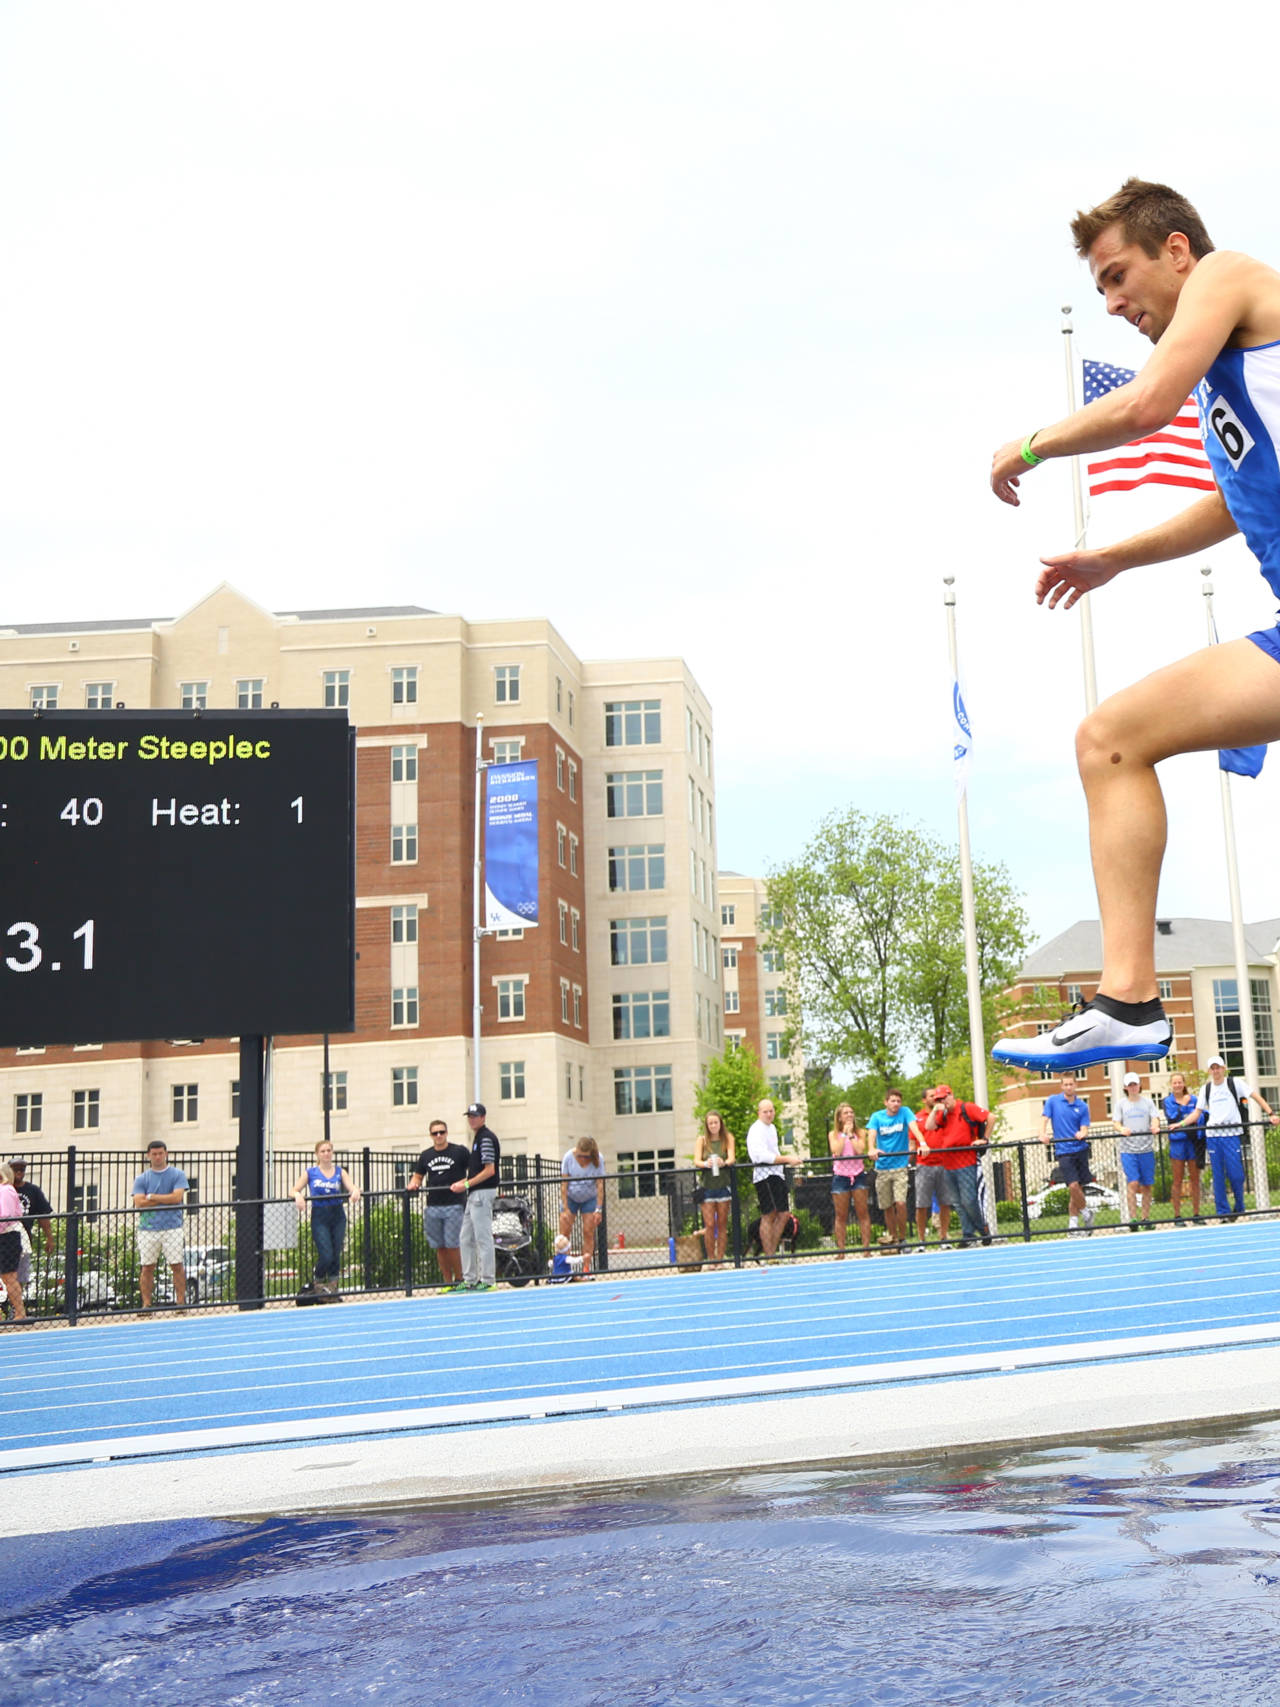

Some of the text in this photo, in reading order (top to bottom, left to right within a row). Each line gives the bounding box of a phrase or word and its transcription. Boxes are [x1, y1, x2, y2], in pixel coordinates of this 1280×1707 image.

[1211, 407, 1244, 461] 6
[40, 735, 129, 761] Meter
[138, 734, 271, 766] Steeplec
[60, 796, 304, 827] 40 Heat: 1
[5, 919, 95, 973] 3.1
